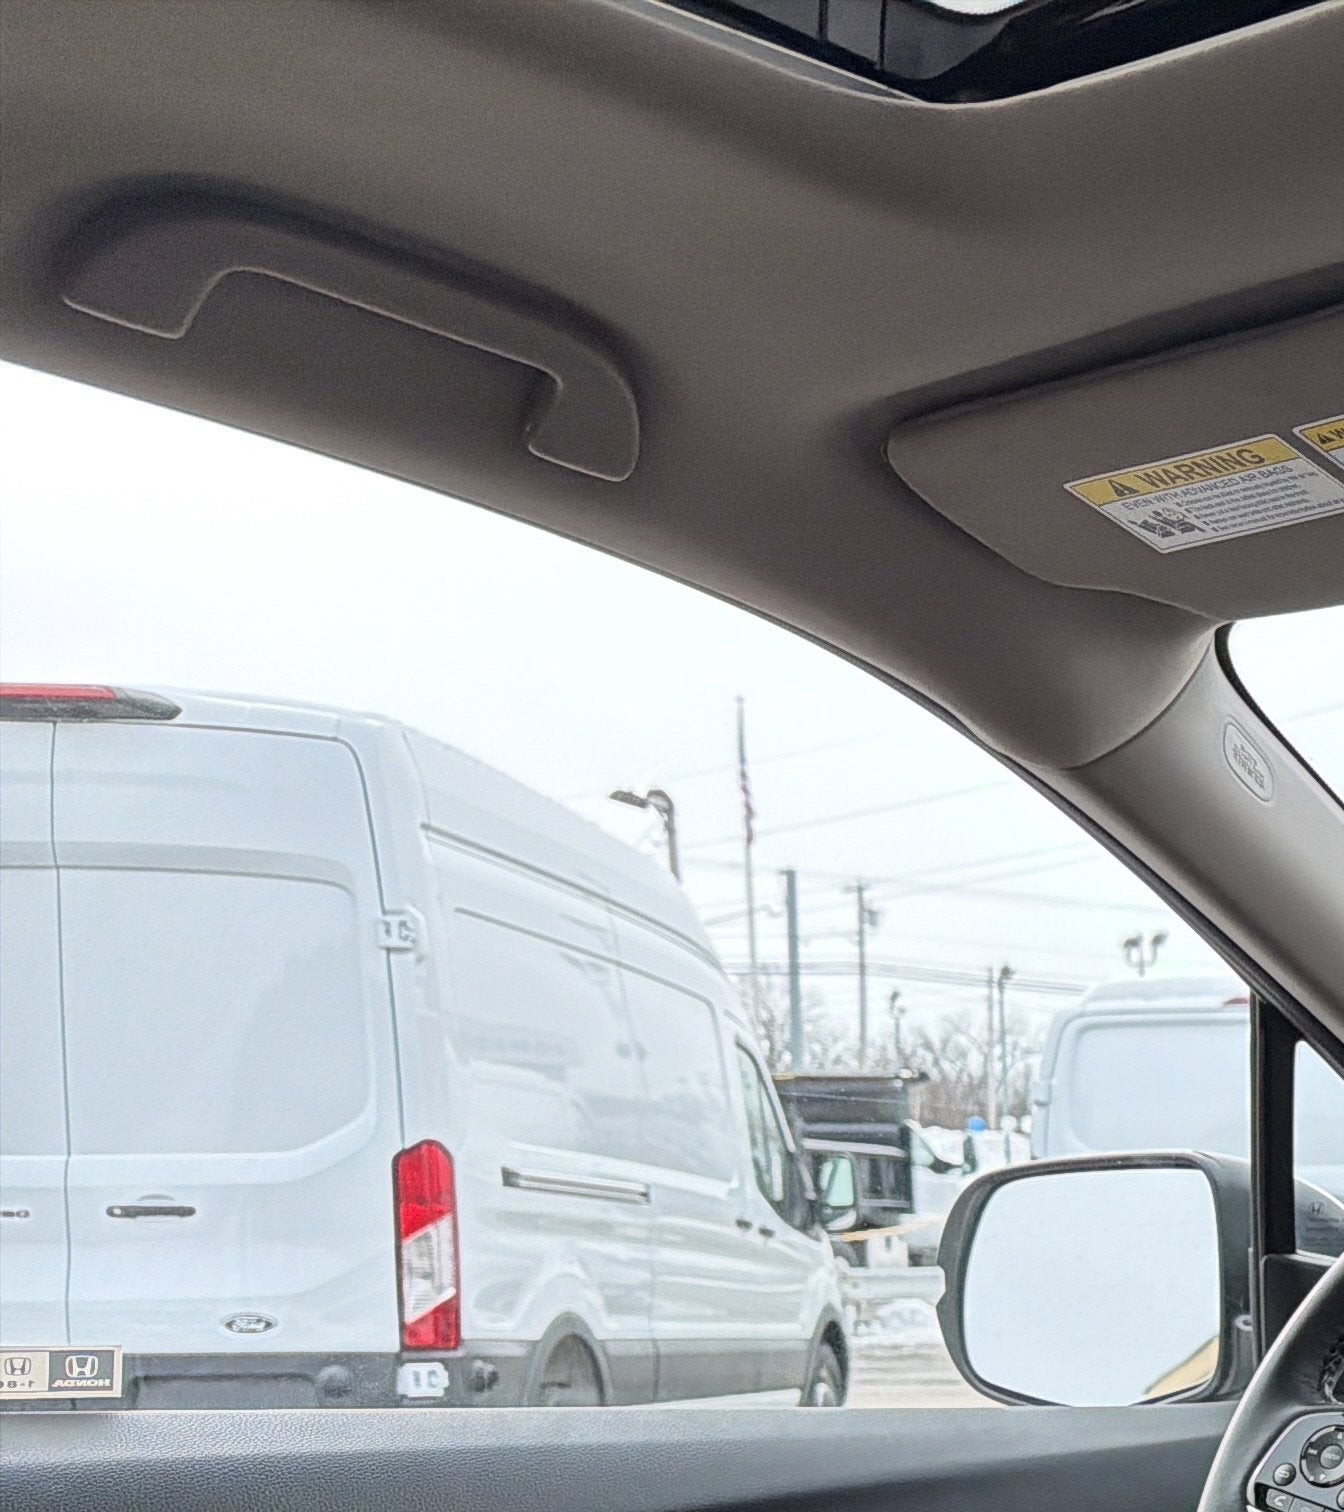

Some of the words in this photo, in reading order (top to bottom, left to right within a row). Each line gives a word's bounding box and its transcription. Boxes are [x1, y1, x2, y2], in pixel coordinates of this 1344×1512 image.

[1121, 497, 1154, 509] EVEN
[1150, 491, 1181, 502] WITH
[1178, 477, 1240, 496] ADVANCED
[1256, 465, 1293, 477] BAGS
[1135, 448, 1266, 489] WARNING
